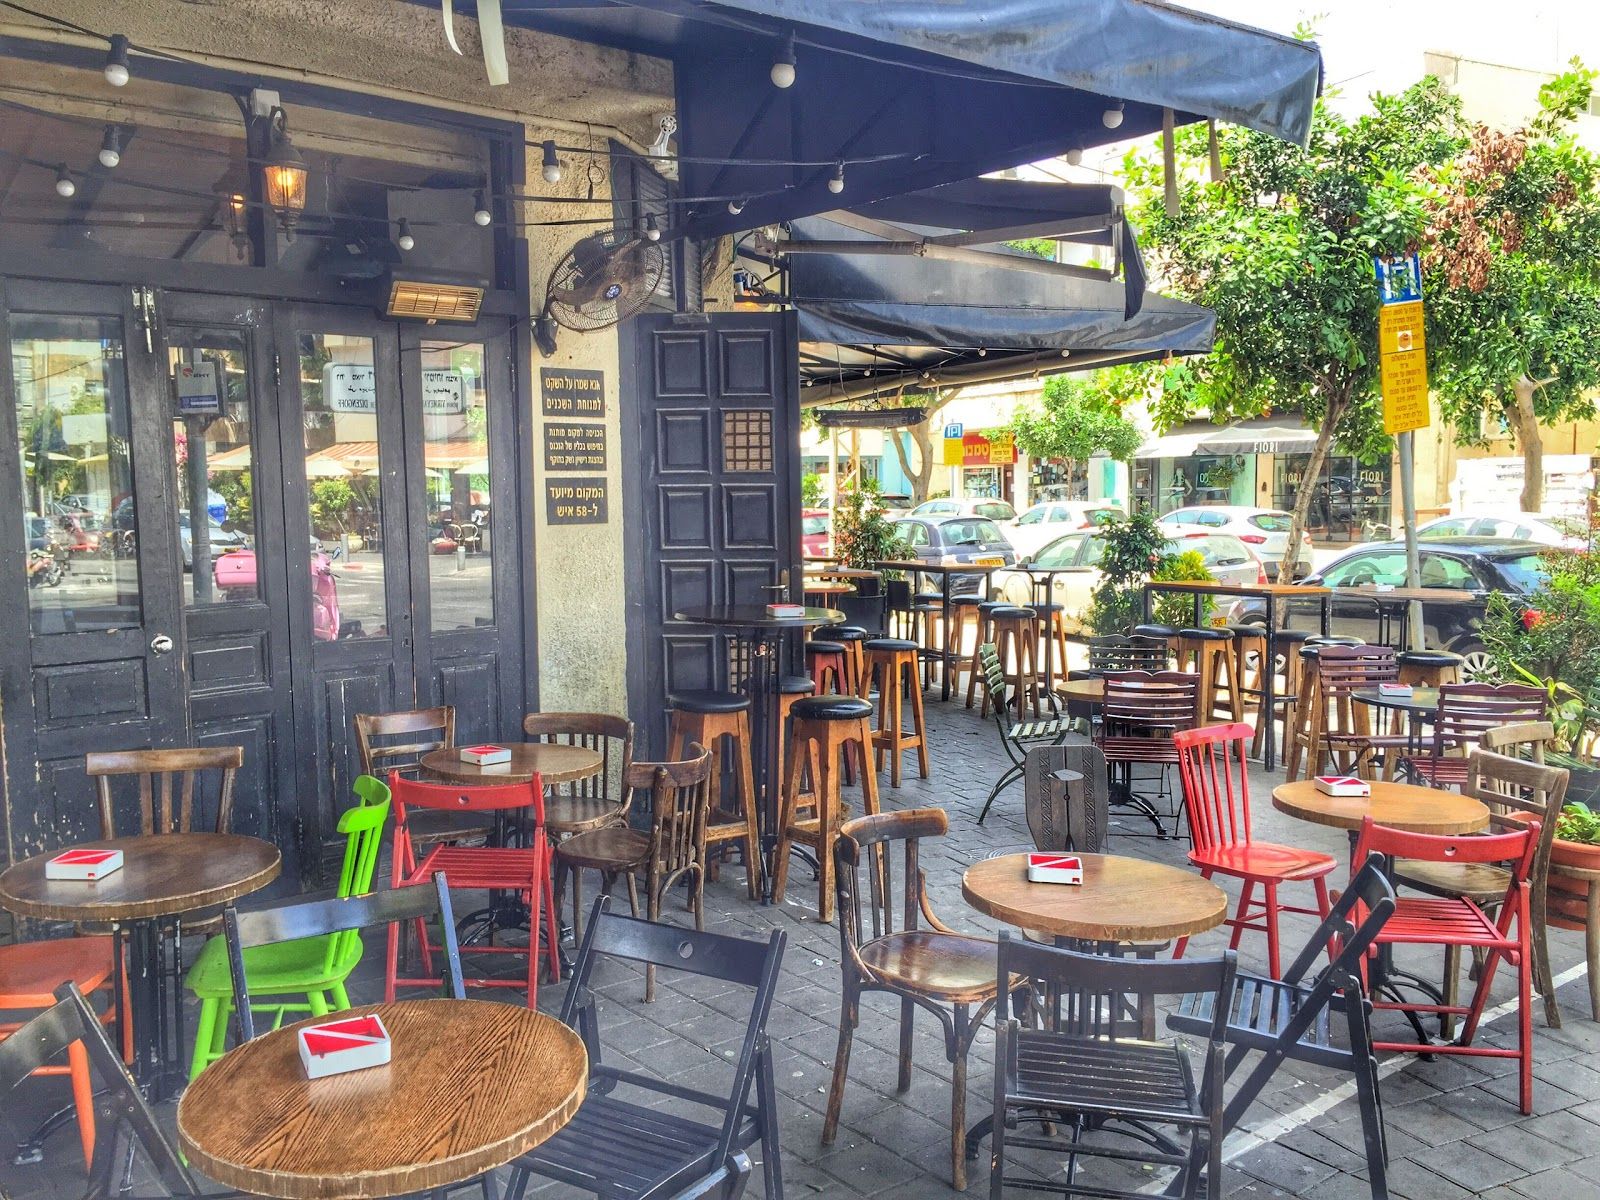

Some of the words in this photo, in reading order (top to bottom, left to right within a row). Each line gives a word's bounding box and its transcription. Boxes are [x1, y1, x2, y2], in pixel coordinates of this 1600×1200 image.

[545, 377, 564, 391] השקט
[564, 376, 573, 391] על
[574, 378, 589, 390] שמרו
[590, 379, 601, 391] אנא
[546, 398, 572, 410] השכנים
[577, 397, 601, 411] למנוחת
[568, 427, 583, 438] למקום
[585, 429, 603, 438] הכניסה
[565, 440, 573, 451] של
[1254, 442, 1278, 453] FIORI
[1281, 473, 1302, 483] FIORI
[1360, 471, 1384, 483] FIORI
[550, 487, 574, 500] מיועד
[576, 487, 604, 501] המקום
[557, 505, 574, 517] איש
[576, 503, 598, 517] ל-58
